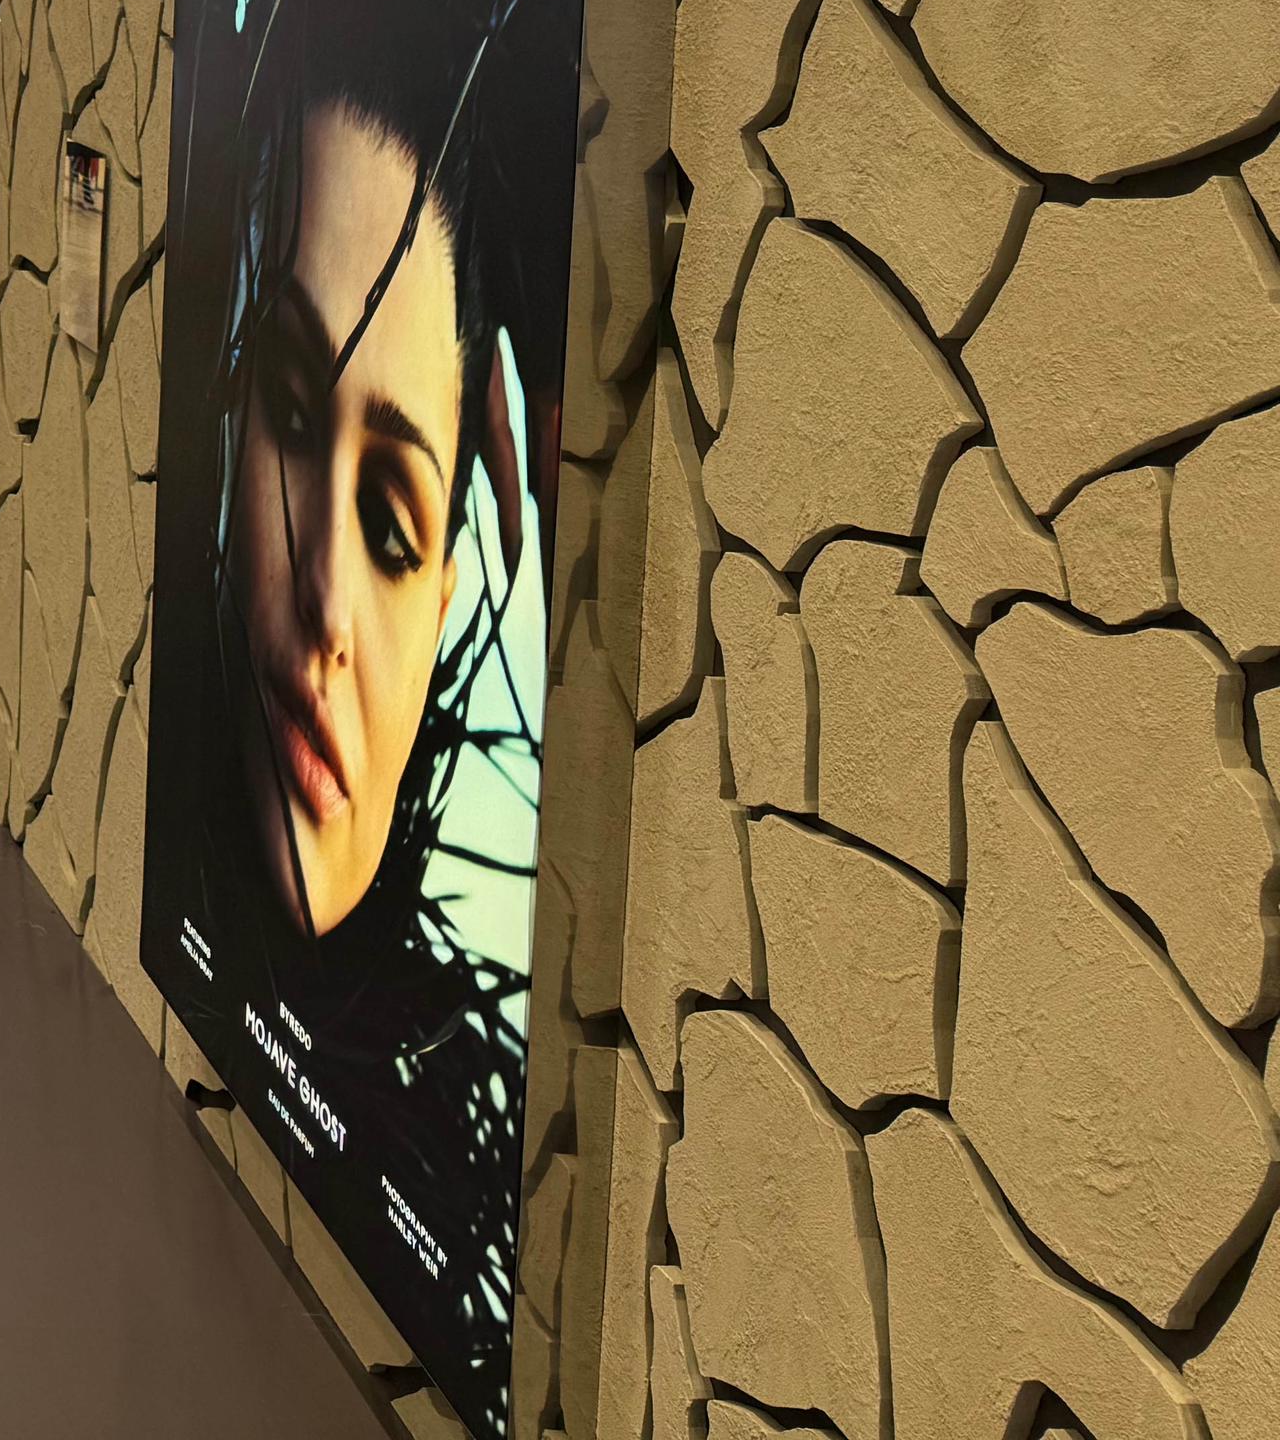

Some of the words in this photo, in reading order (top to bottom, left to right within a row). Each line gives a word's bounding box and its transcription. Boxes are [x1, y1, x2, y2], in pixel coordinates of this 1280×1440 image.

[279, 1001, 313, 1051] BYREDO
[245, 1001, 297, 1089] MOJAVE
[299, 1075, 347, 1152] GHOST
[268, 1087, 281, 1112] EAU
[280, 1105, 290, 1125] DE
[289, 1118, 315, 1159] PARFUM
[381, 1174, 436, 1253] PHOTOGRAPHY
[437, 1246, 448, 1268] BY
[388, 1204, 417, 1250] HARLEY
[418, 1243, 438, 1281] WEIR
